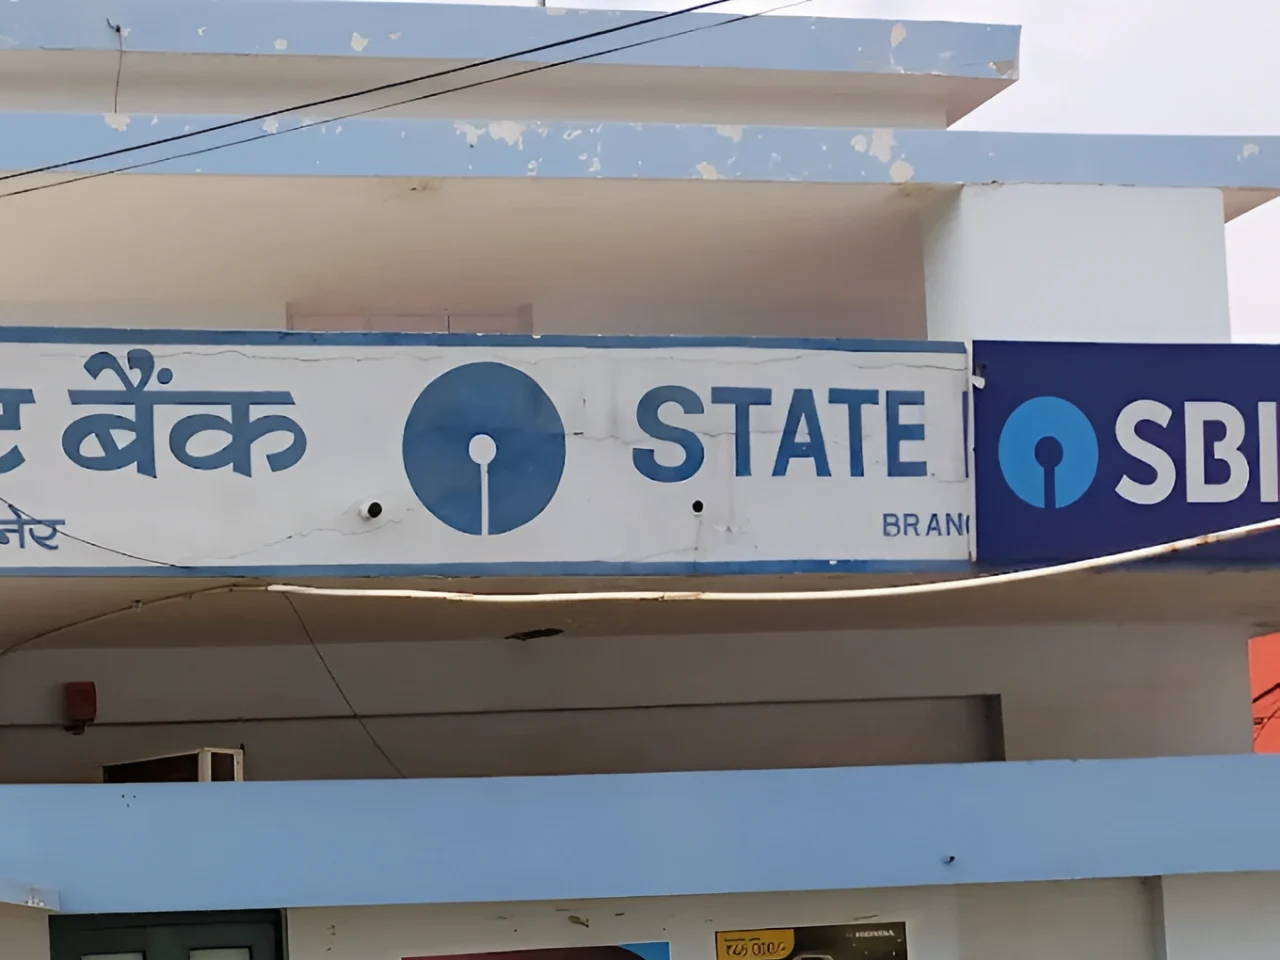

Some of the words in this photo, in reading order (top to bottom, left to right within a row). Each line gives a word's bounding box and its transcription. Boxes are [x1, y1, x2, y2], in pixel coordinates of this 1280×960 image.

[61, 348, 308, 479] बैंक
[632, 385, 928, 483] STATE
[1115, 399, 1279, 505] SBI
